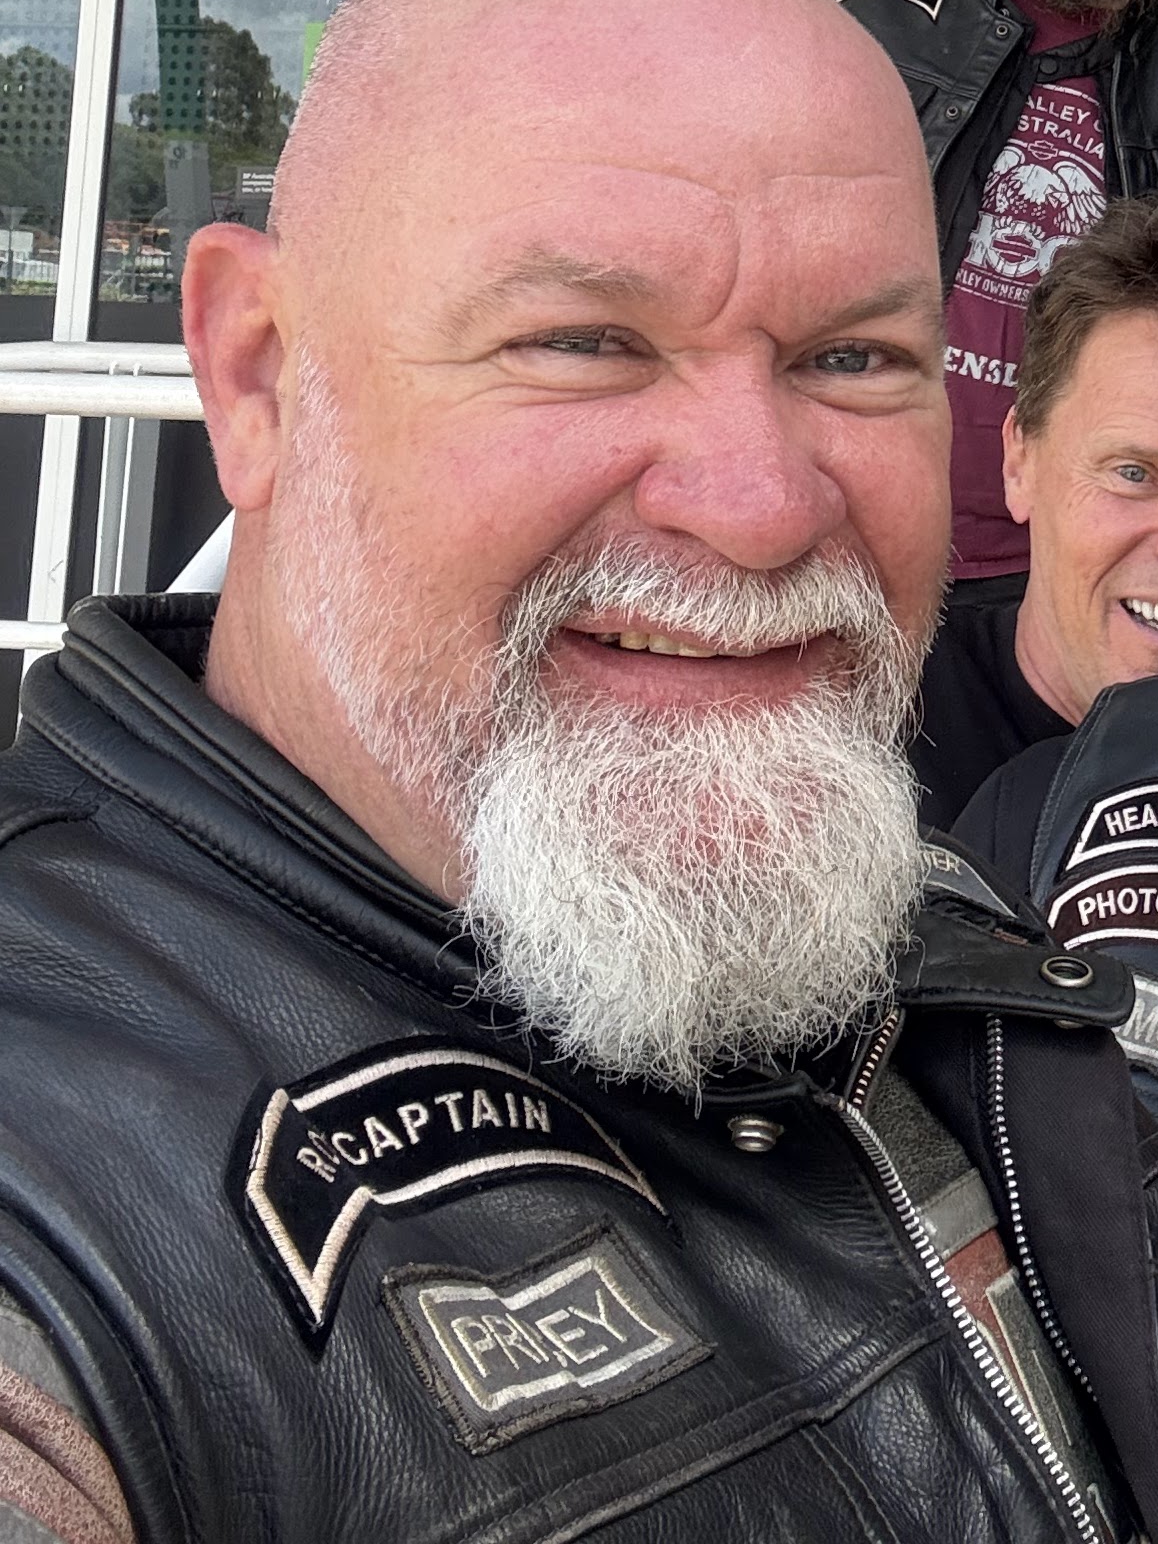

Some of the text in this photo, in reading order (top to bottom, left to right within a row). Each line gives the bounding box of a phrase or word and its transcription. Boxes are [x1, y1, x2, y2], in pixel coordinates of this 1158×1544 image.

[1017, 114, 1105, 160] STRALIA
[981, 278, 1031, 303] OWNERS
[943, 345, 1019, 389] ENSL
[331, 1088, 553, 1166] CAPTAIN
